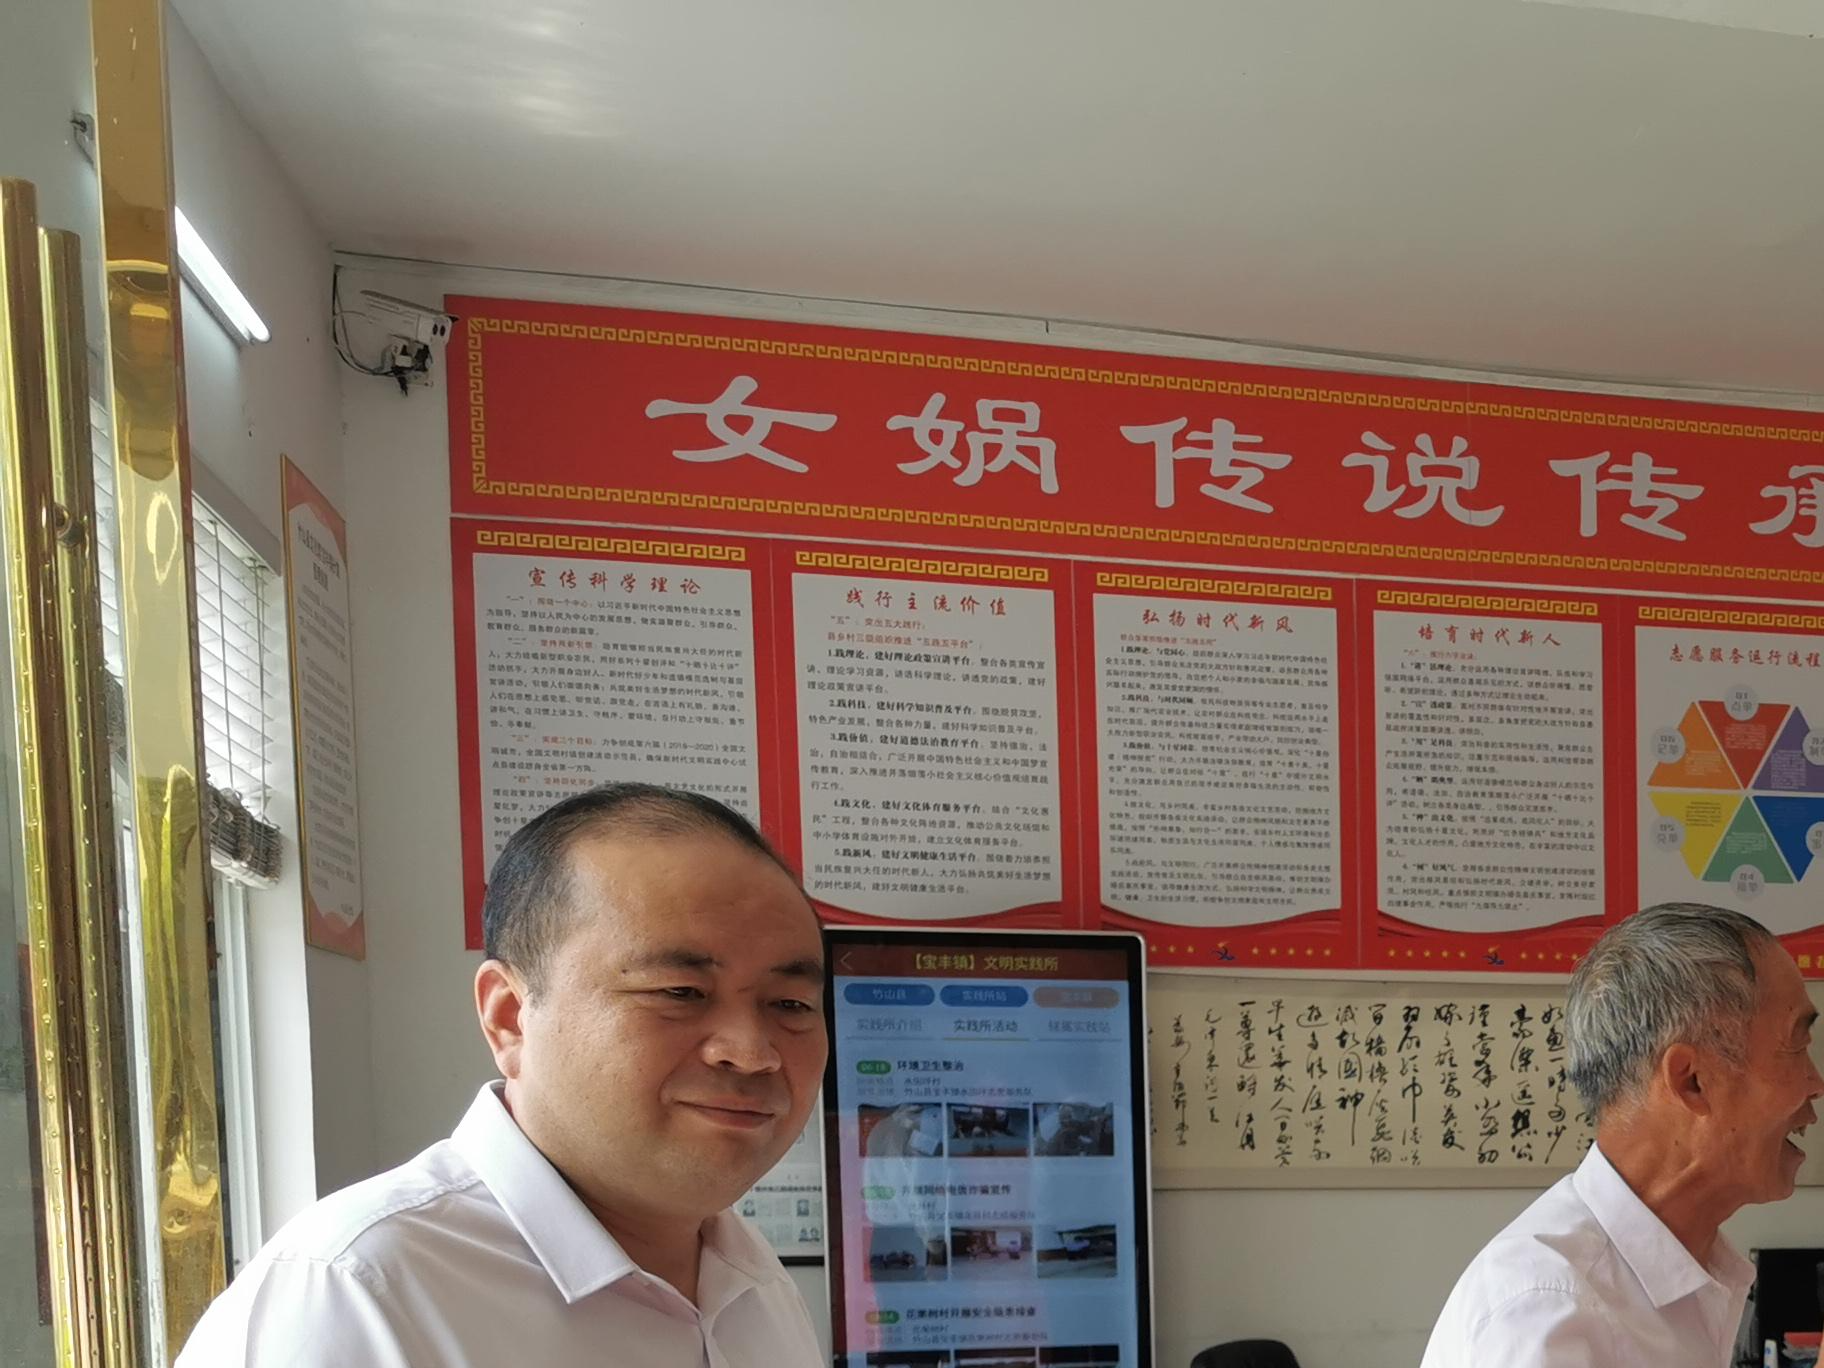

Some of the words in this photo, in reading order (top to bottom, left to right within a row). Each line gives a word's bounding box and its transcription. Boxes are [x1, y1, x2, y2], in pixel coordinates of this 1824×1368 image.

[527, 566, 702, 598] 宣传科学理论
[844, 587, 1006, 616] 践行主流价值
[1141, 606, 1294, 634] 弘扬时代新风
[1417, 622, 1561, 648] 培育时代新人
[1669, 643, 1822, 668] 志愿服务运行流程
